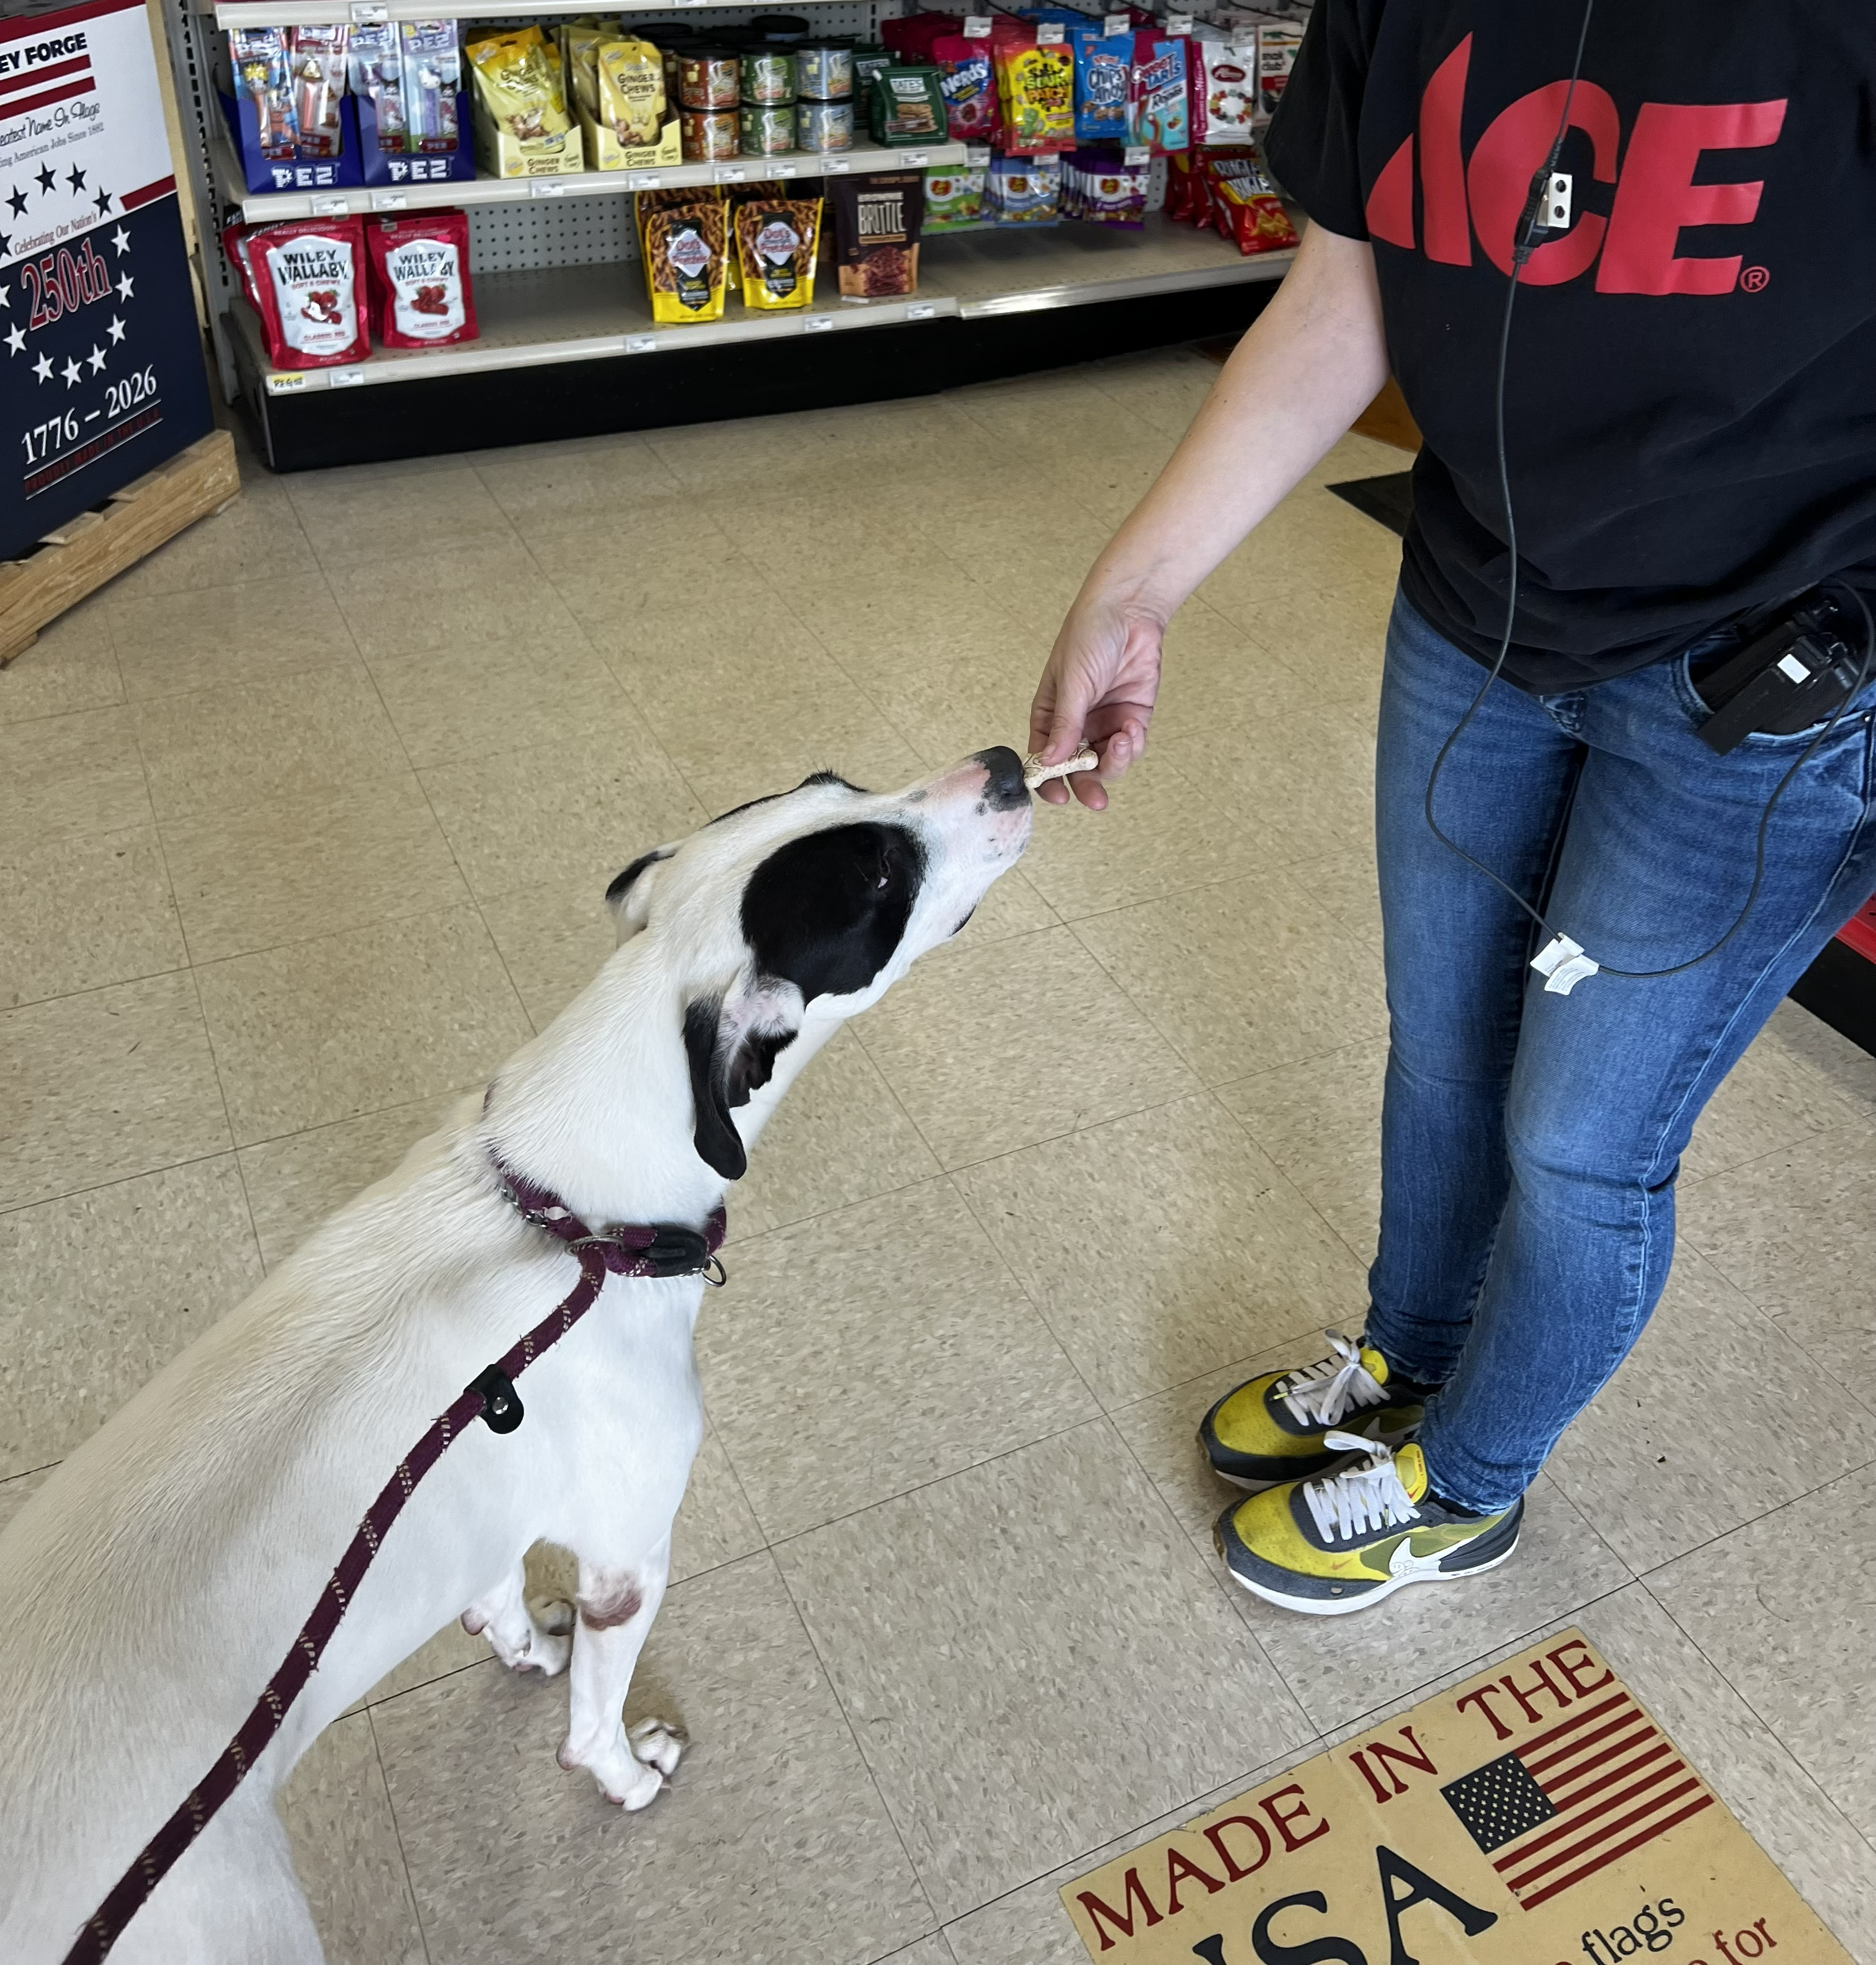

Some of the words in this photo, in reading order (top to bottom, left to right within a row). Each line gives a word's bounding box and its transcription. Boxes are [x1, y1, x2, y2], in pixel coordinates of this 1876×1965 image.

[25, 32, 87, 65] FORGE
[408, 32, 450, 50] PEZ
[621, 84, 655, 94] CHEWS
[14, 144, 50, 163] American
[50, 136, 66, 149] Jobs
[68, 131, 87, 143] Since
[625, 151, 656, 159] GINGER
[388, 159, 448, 182] PEZ
[528, 158, 560, 167] GINGER
[529, 166, 558, 174] CHEWS
[627, 158, 656, 167] CHEWS
[272, 165, 334, 189] PEZ
[857, 202, 907, 234] BRITTLE
[14, 231, 55, 256] Celebrating
[55, 225, 69, 238] Our
[71, 211, 97, 233] Nation's
[282, 249, 337, 266] WILEY
[398, 250, 447, 265] WILEY
[21, 237, 112, 331] 250th
[278, 261, 349, 286] WALLABY
[20, 407, 79, 465] 1776
[105, 363, 157, 419] 2026
[73, 440, 100, 466] MADE
[1076, 1783, 1331, 1951] MADE
[1349, 1726, 1439, 1804] IN
[1457, 1639, 1615, 1741] THE
[1192, 1844, 1498, 1965] SA
[1581, 1897, 1686, 1965] flags
[1713, 1917, 1778, 1965] for
